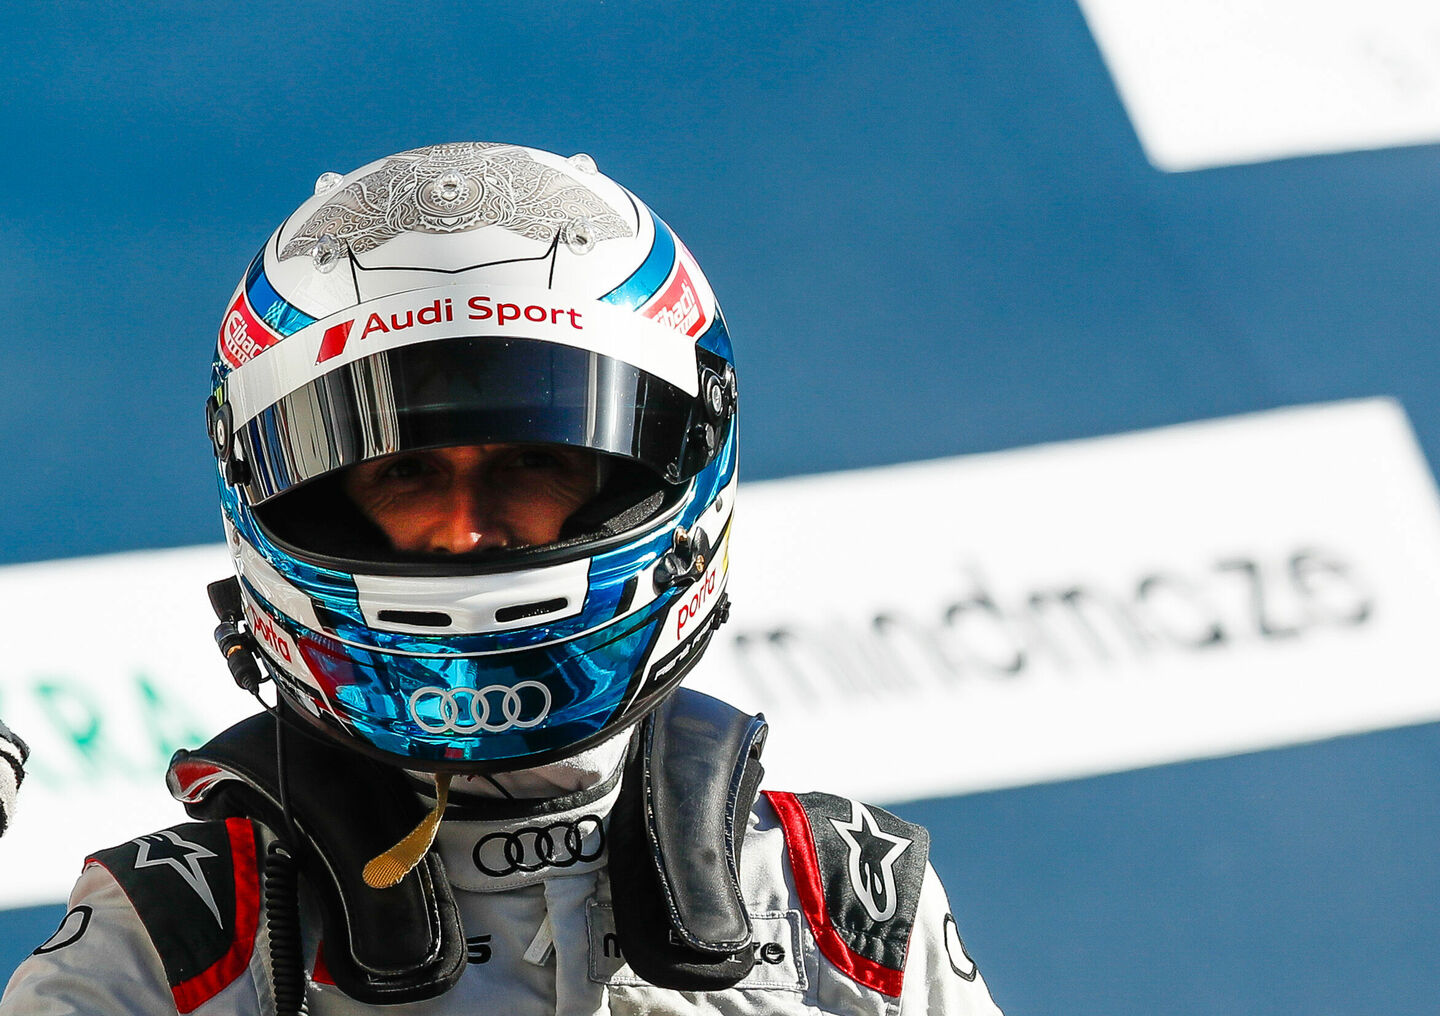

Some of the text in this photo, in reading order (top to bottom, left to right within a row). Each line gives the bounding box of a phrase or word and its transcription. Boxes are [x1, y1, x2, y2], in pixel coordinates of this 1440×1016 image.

[223, 309, 271, 363] Eibac
[360, 295, 584, 341] Audi Sport
[675, 567, 717, 641] porta
